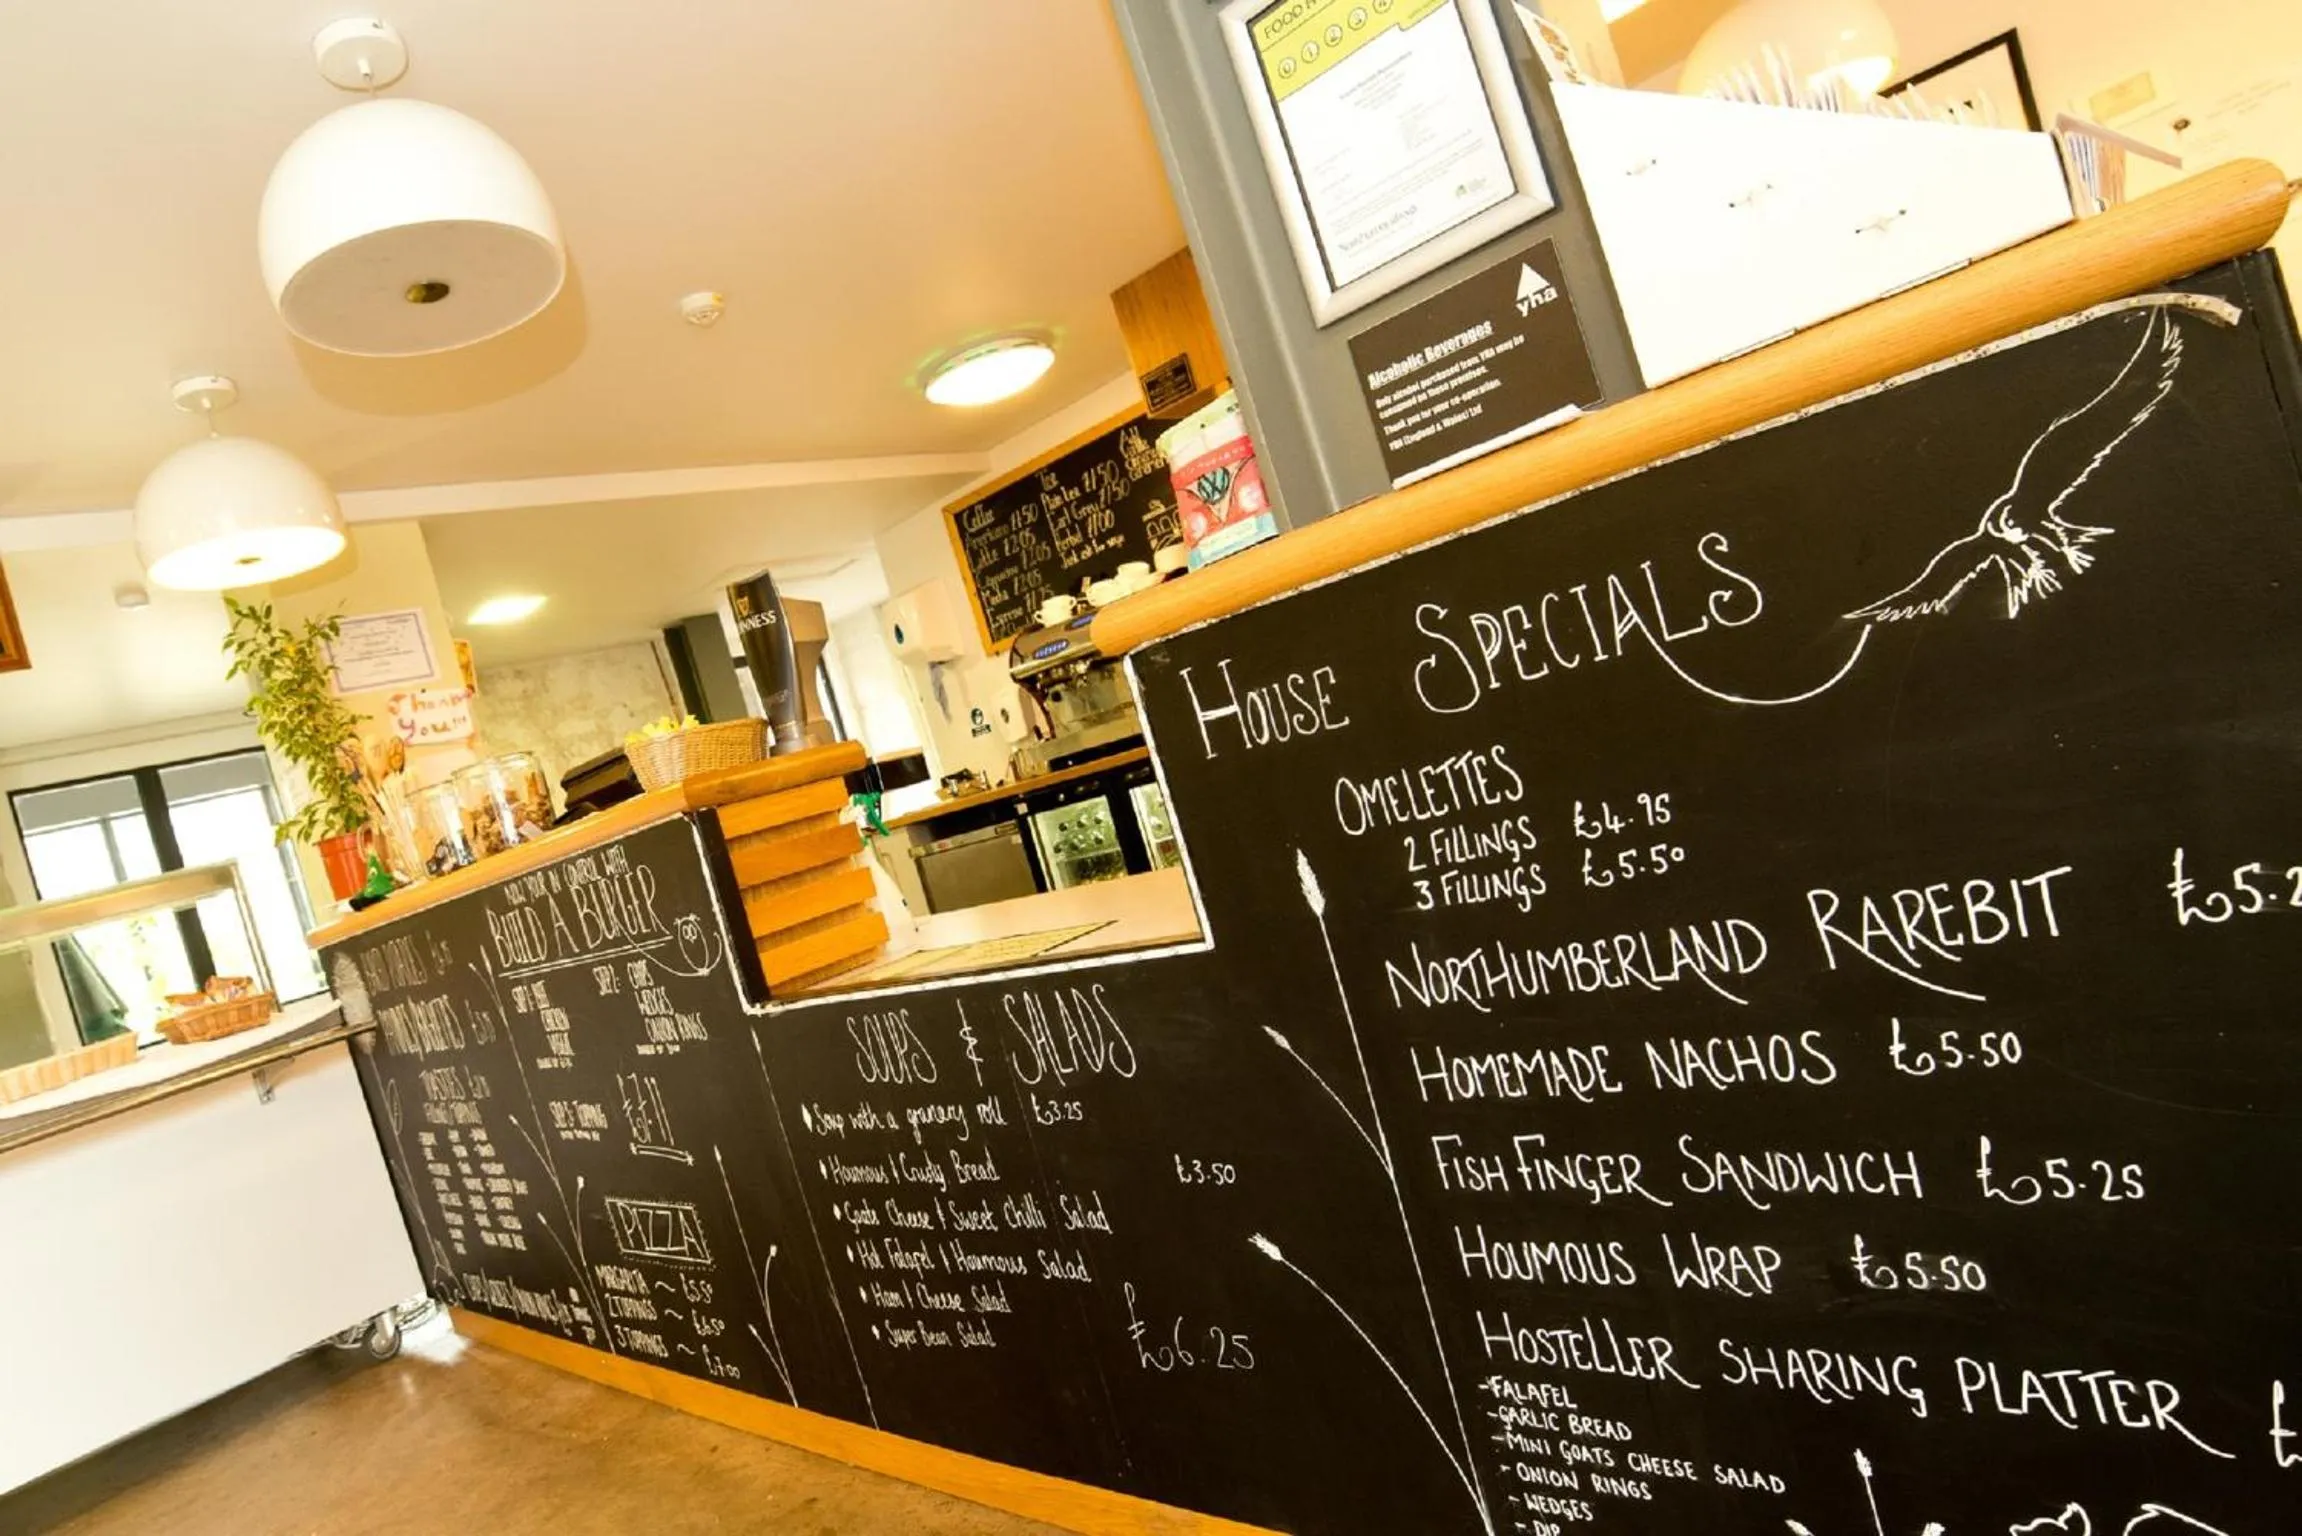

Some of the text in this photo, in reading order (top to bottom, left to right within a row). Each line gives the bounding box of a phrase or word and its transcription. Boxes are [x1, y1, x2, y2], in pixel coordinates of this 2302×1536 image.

[1516, 287, 1558, 317] yha
[1368, 320, 1494, 391] Alcoholic Beverages
[1180, 531, 1763, 760] HOUSE SPECIALS
[1335, 744, 1525, 836] OMELETTES
[1404, 792, 1672, 873] 2 FILLINGS £4.95
[1413, 845, 1685, 912] 3 FILLINGS £5.50
[486, 905, 549, 968] BUILD
[548, 890, 580, 956] A
[570, 864, 673, 950] BURGER
[1385, 919, 1767, 1013] NORTHUMBERLAND
[1807, 866, 2073, 1001] RAREBIT
[846, 1008, 937, 1085] SOUPS
[1003, 983, 1136, 1087] SALADS
[1411, 1018, 2023, 1103] HOMEMADE NACHOS £5.50
[813, 1102, 845, 1139] Soup
[1030, 1092, 1083, 1125] £3.25
[949, 1145, 1000, 1184] Bread
[1174, 1153, 1236, 1185] £3.50
[1432, 1134, 2146, 1211] FISH FINGER SANDWICH £5.25
[617, 1200, 704, 1258] PIZZA
[1060, 1190, 1113, 1235] Salad
[1037, 1249, 1092, 1283] Salad
[1454, 1225, 1988, 1297] HOUMOUS WRAP £5.50
[971, 1278, 1012, 1313] Salad
[1124, 1282, 1254, 1371] £6.25
[956, 1317, 997, 1348] Salad
[1476, 1310, 1701, 1390] HOSTELLER
[1719, 1338, 1929, 1419] SHARING
[1957, 1357, 2237, 1459] PLATTER
[1568, 1413, 1632, 1441] BREAD
[1516, 1462, 1652, 1500] ONION RINGS
[1559, 1439, 1615, 1468] GOATS
[1627, 1451, 1698, 1481] CHEESE
[1713, 1463, 1786, 1494] SALAD
[1524, 1492, 1593, 1522] WEDGES
